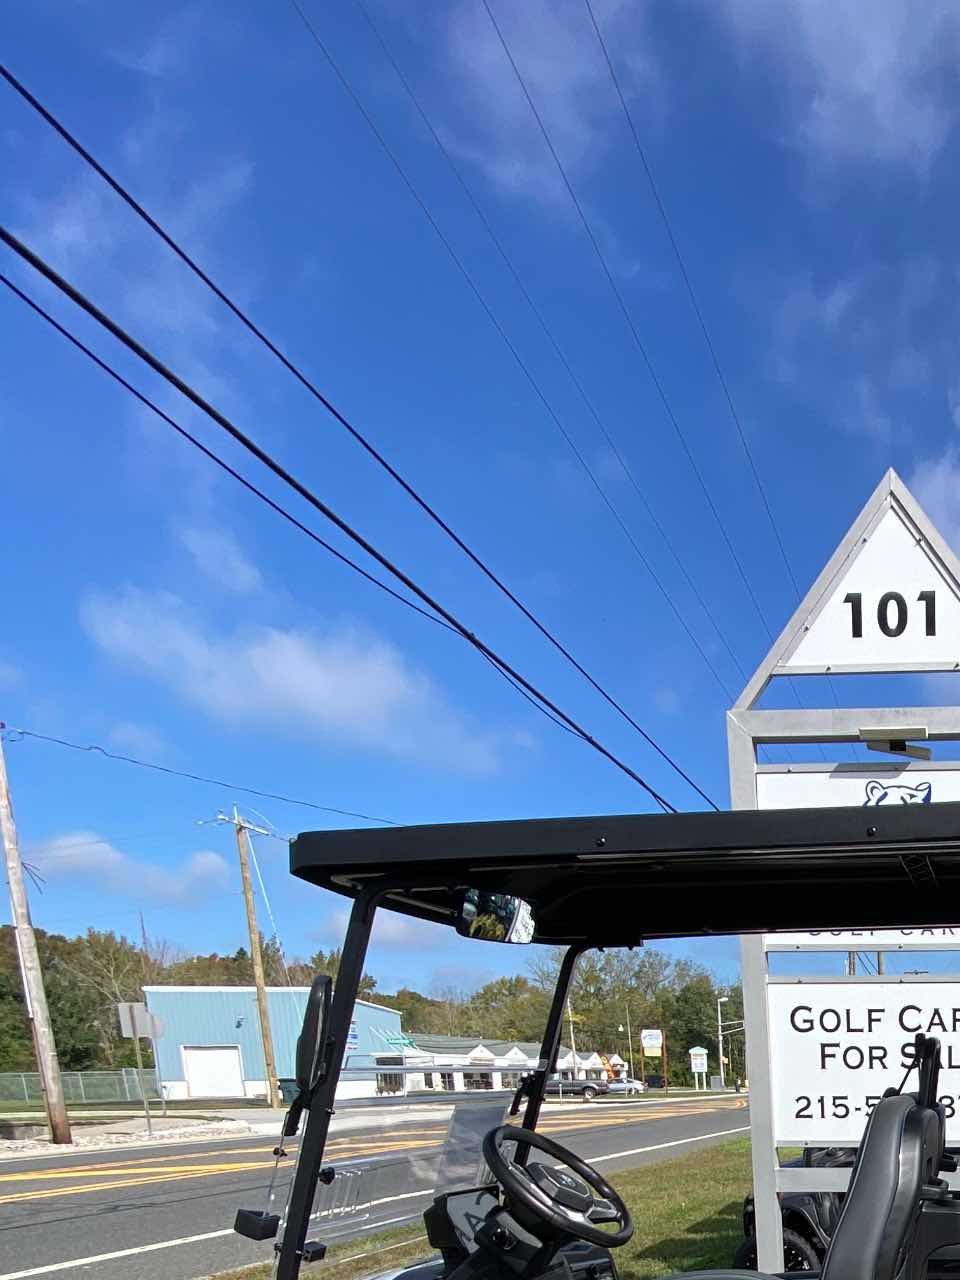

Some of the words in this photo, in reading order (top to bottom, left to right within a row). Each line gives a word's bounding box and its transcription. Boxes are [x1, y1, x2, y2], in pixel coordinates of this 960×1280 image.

[843, 590, 936, 638] 101
[790, 1005, 886, 1033] GOLF
[819, 1042, 889, 1070] FOR
